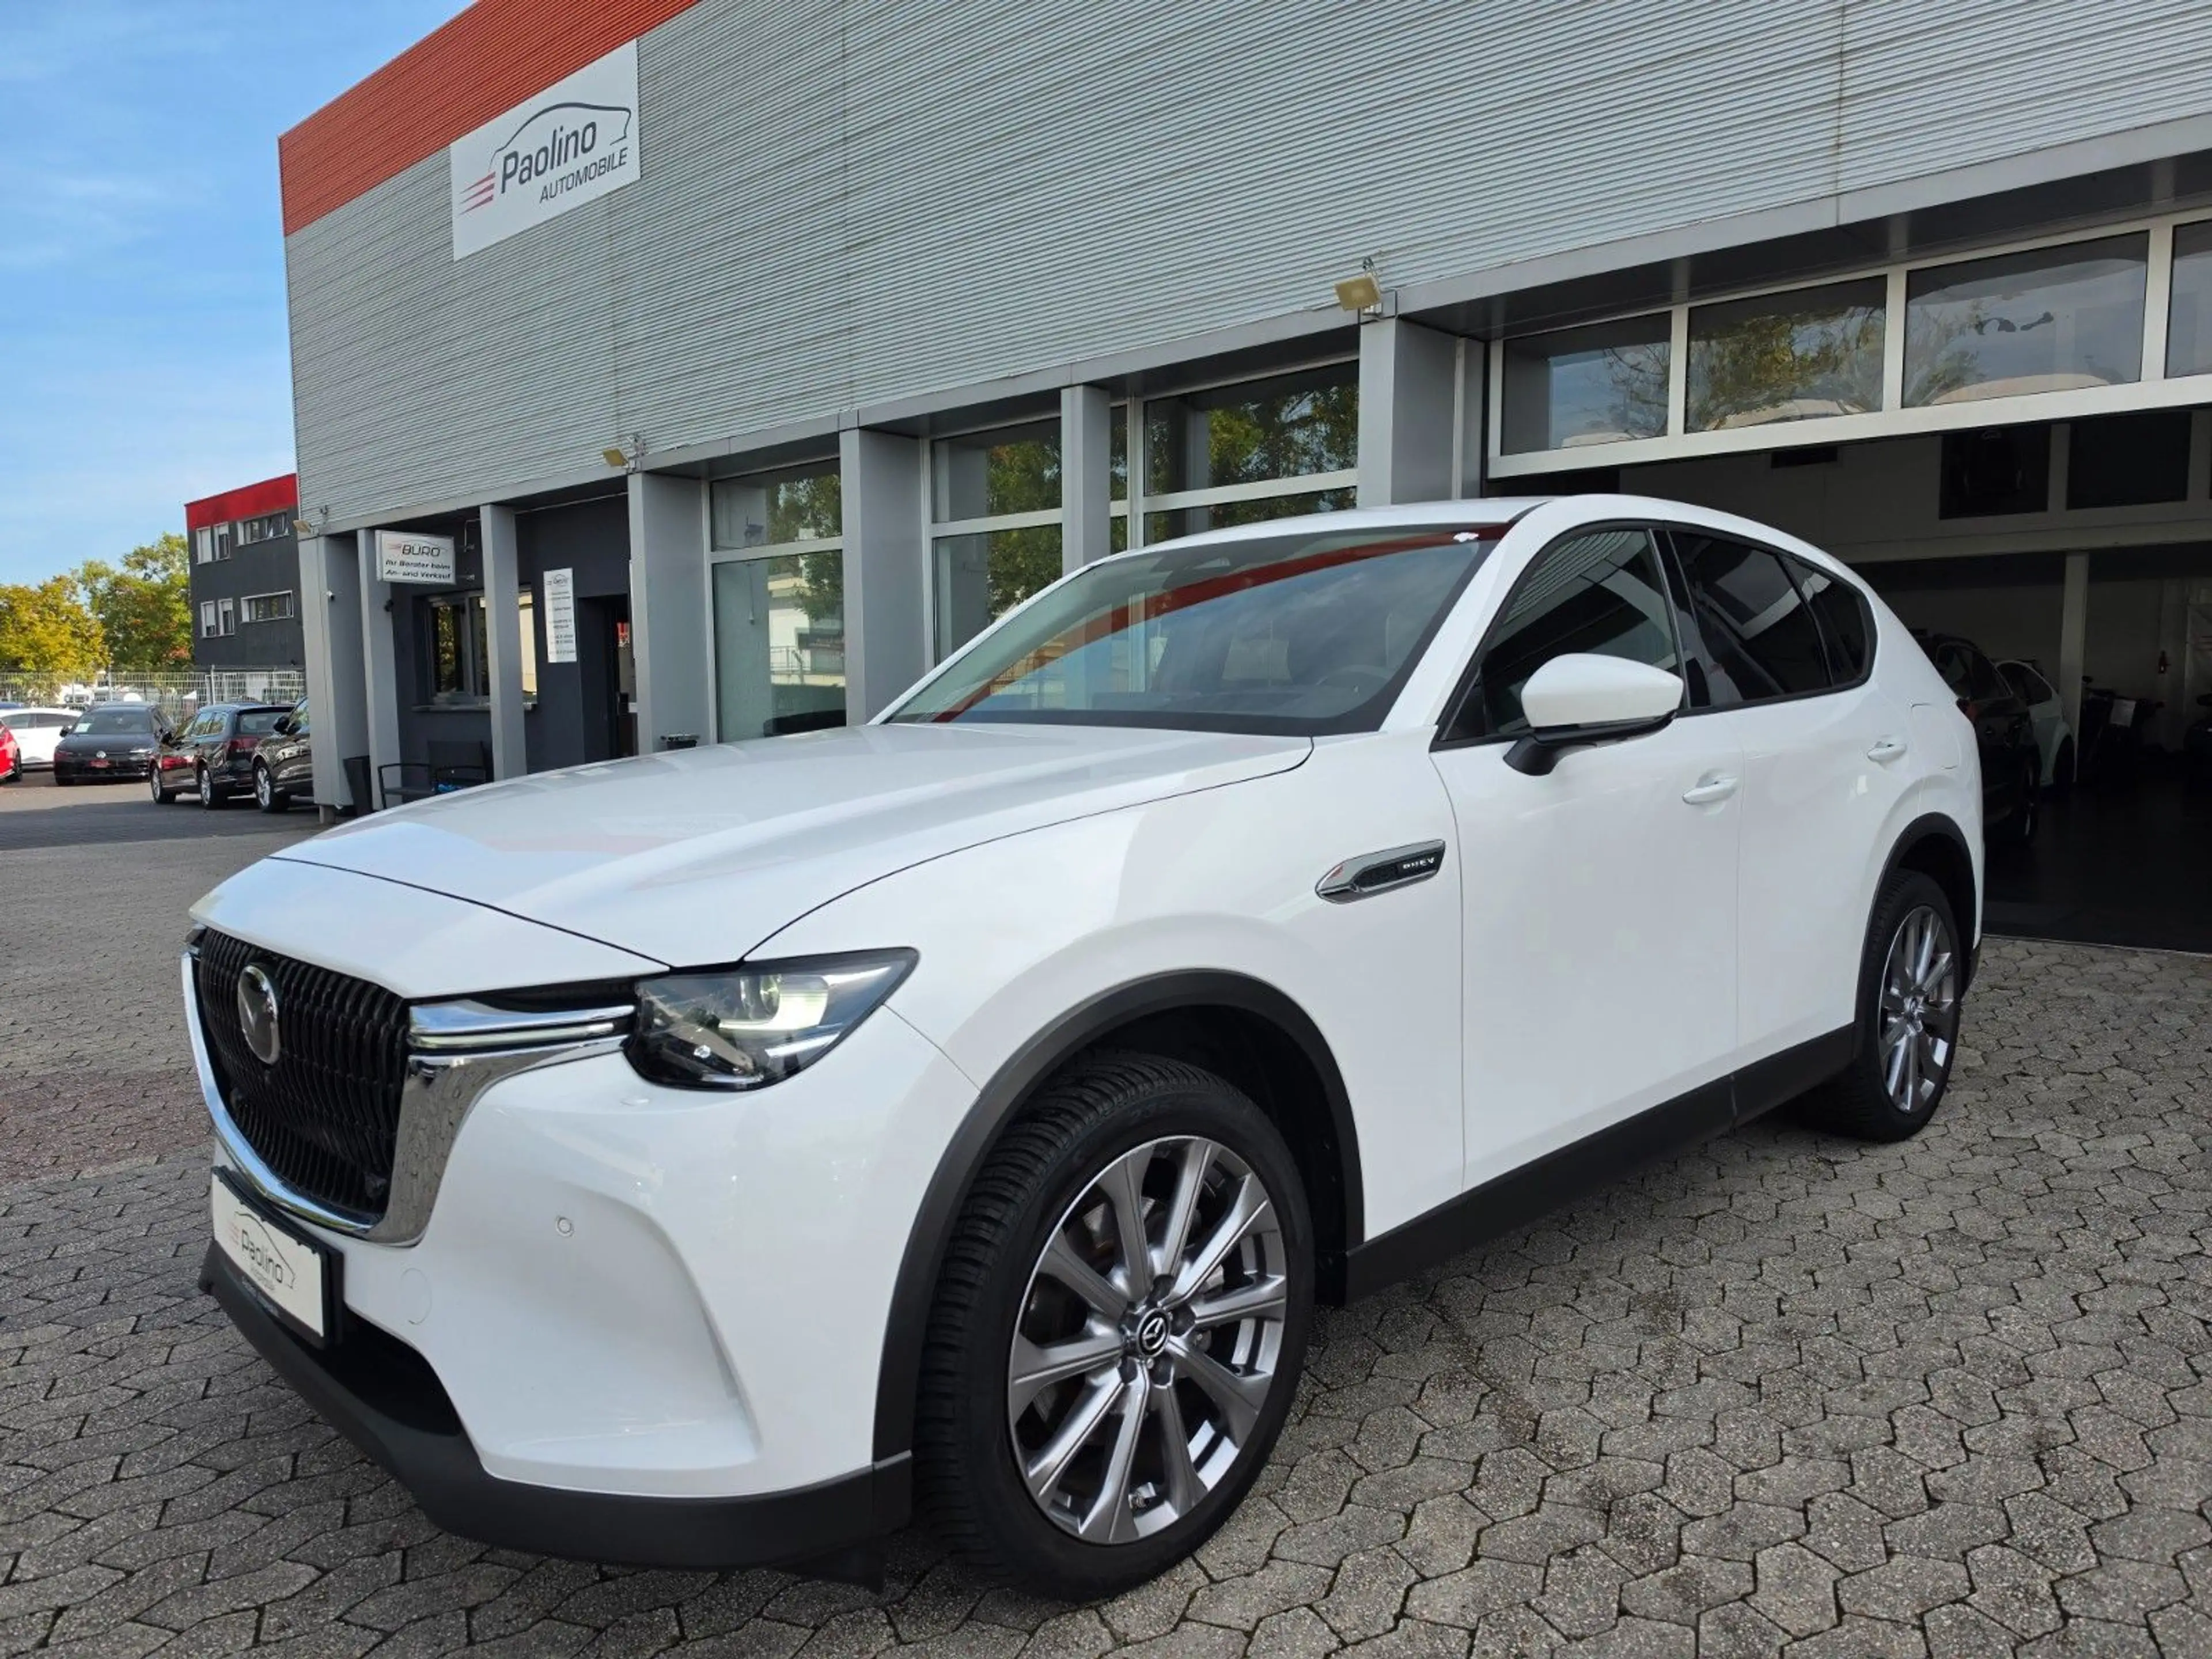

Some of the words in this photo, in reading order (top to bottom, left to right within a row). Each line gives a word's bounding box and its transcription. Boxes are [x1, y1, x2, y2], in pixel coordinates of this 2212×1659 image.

[501, 121, 597, 194] Paolino
[539, 147, 628, 203] AUTOMOBILE
[402, 544, 441, 557] BÜRO
[241, 1228, 283, 1284] Paolino
